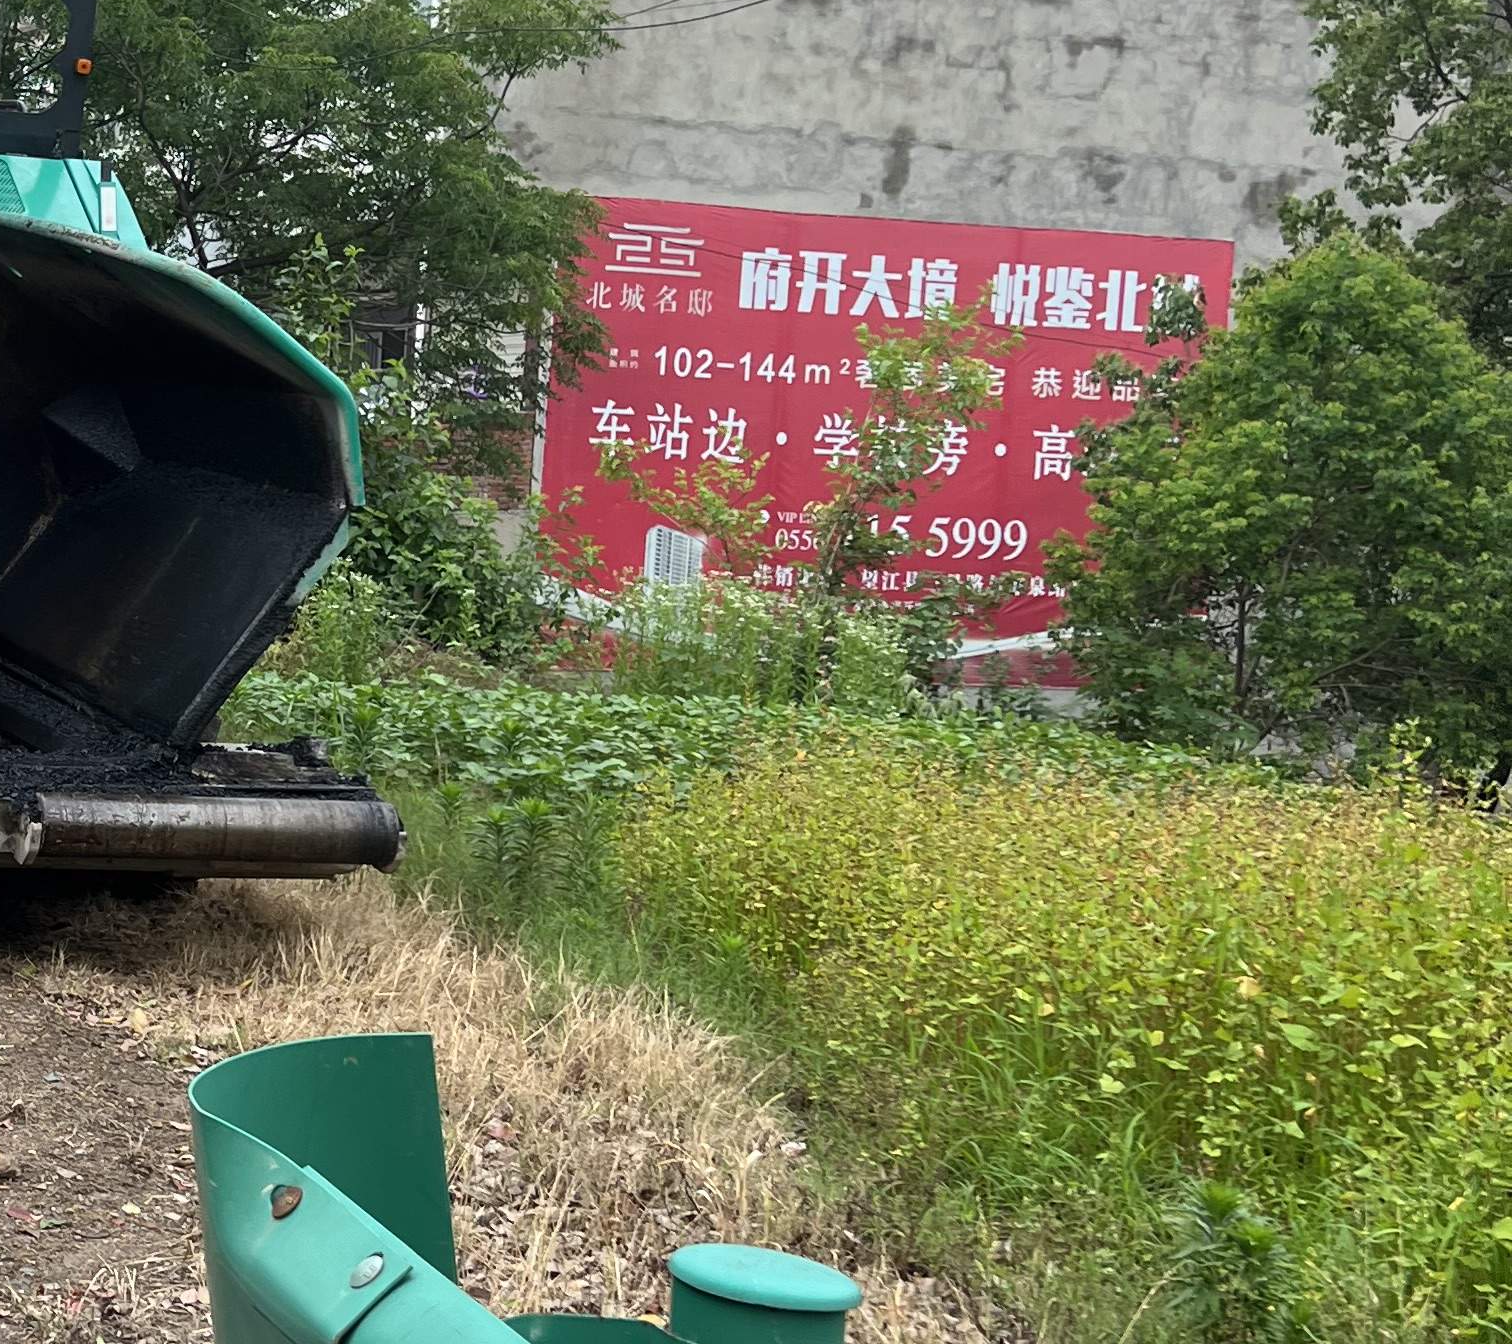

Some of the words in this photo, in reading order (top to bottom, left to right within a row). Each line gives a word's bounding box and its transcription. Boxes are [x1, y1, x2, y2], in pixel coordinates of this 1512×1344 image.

[586, 281, 714, 317] 北城名邸
[739, 247, 959, 321] 府开大境
[991, 262, 1201, 335] 悦鉴北
[1031, 366, 1178, 402] 恭迎品
[776, 511, 798, 524] VIP
[925, 516, 1028, 561] 5999
